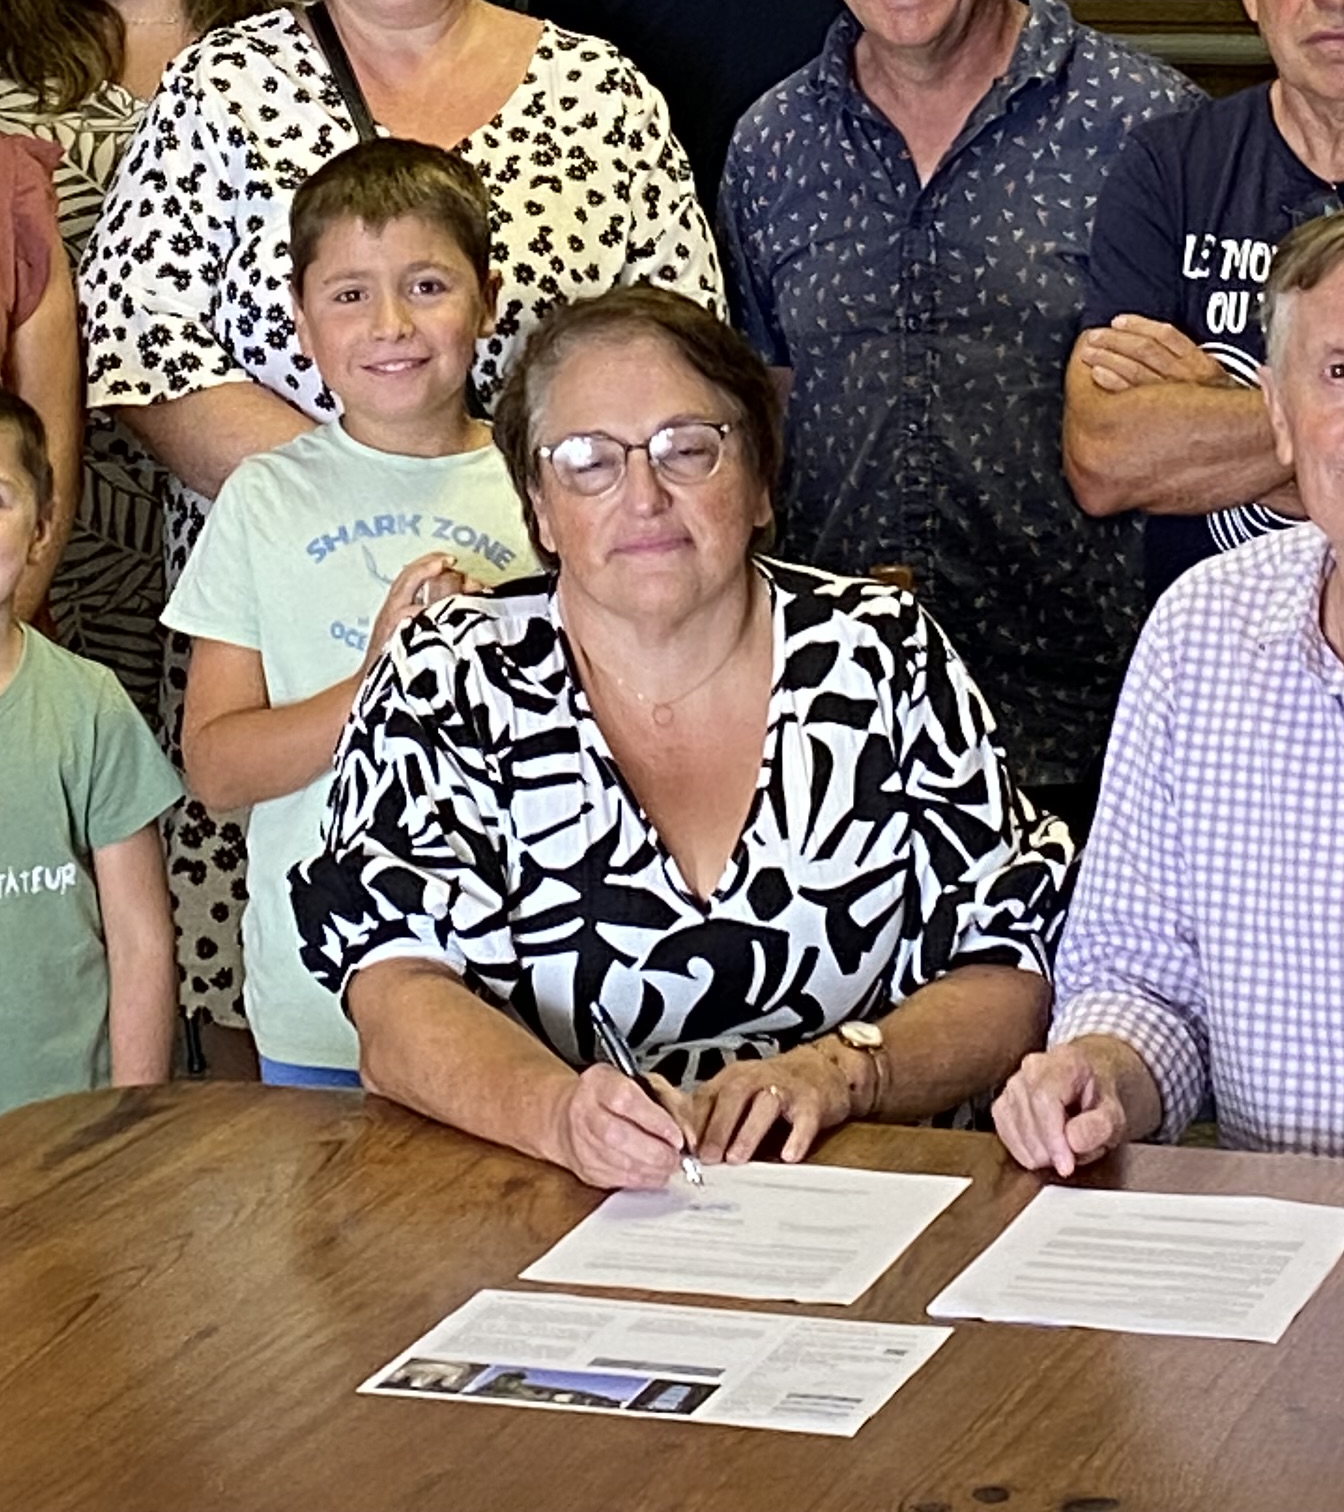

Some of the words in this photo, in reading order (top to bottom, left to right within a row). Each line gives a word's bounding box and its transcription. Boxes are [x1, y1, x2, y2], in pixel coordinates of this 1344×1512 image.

[1182, 234, 1216, 279] LE
[1220, 238, 1278, 282] MO
[1206, 291, 1250, 334] OU
[306, 514, 423, 564] SHARK
[431, 516, 517, 571] ZONE
[330, 620, 367, 652] OCE
